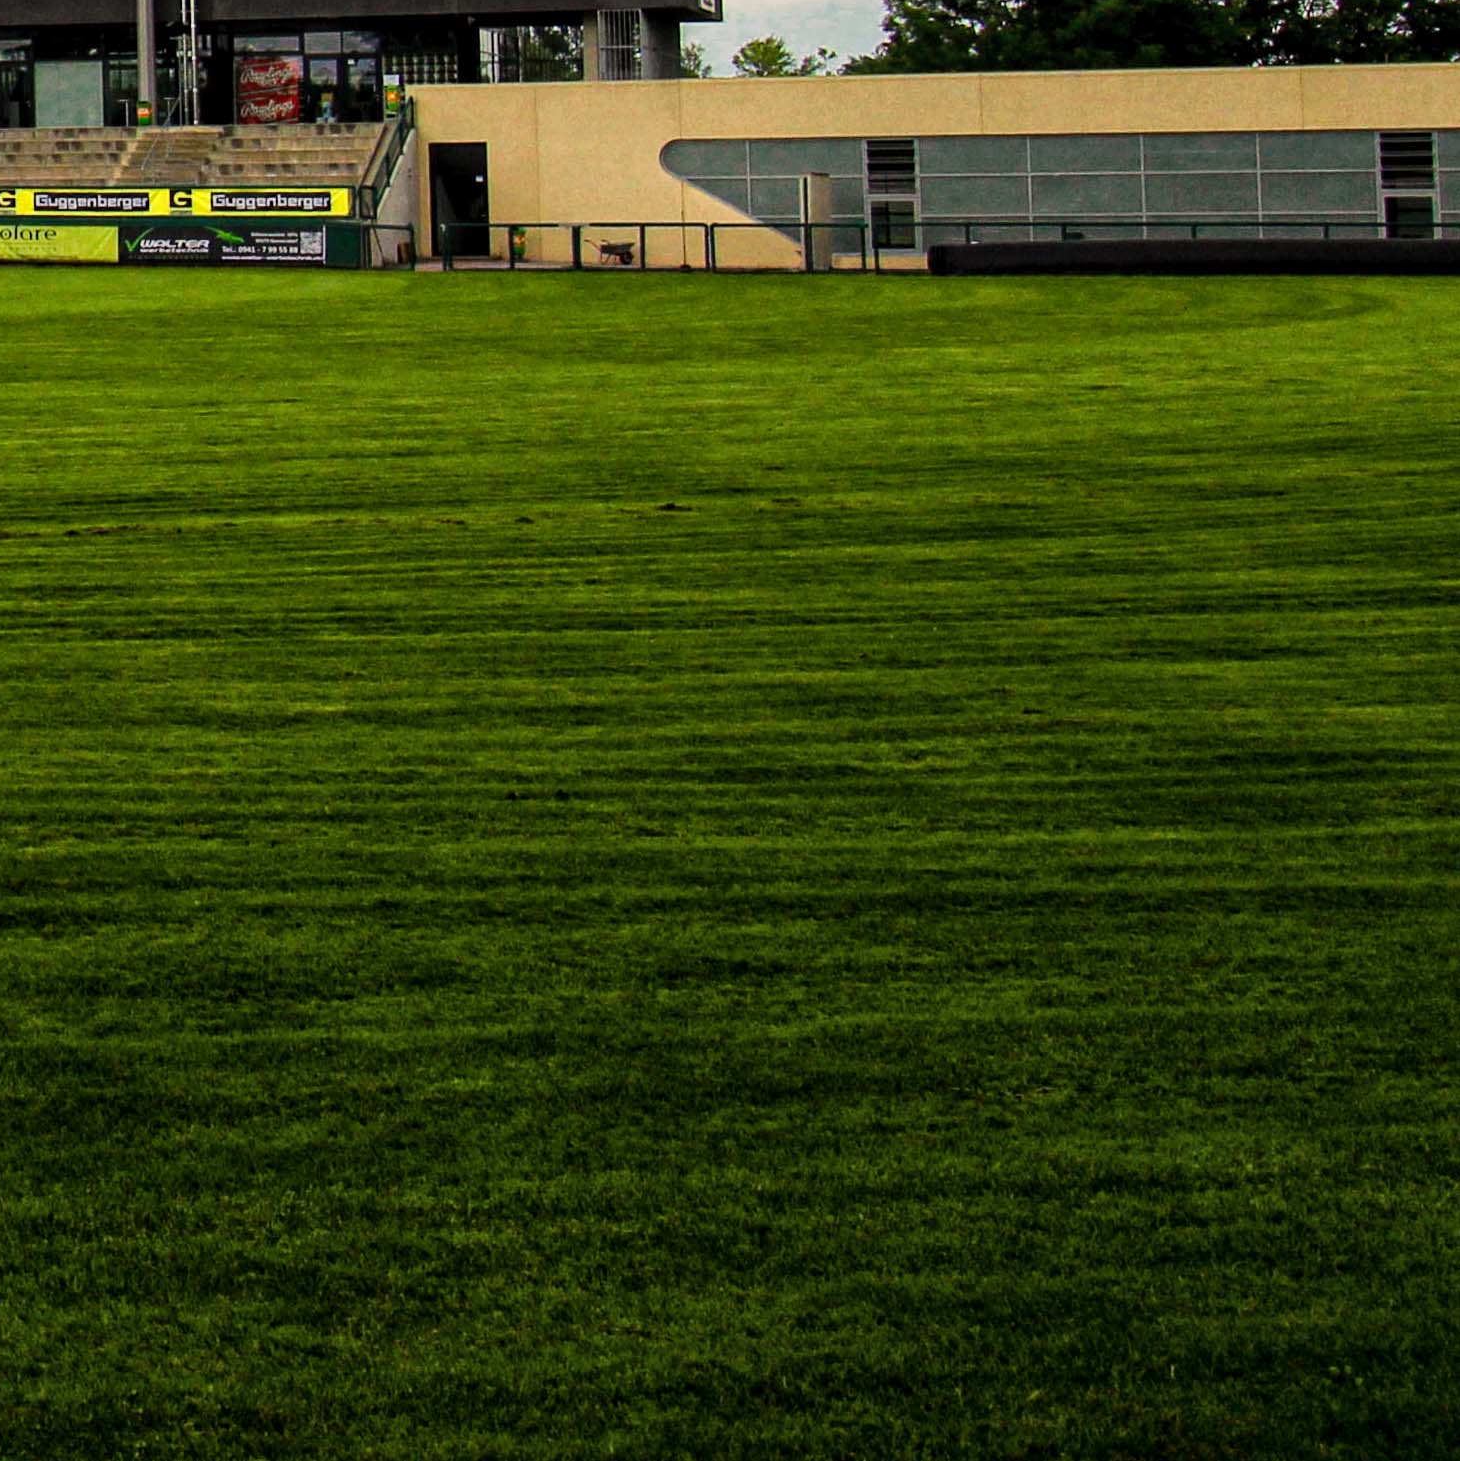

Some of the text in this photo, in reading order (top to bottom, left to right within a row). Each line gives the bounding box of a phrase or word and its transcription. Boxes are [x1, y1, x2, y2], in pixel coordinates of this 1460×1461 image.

[35, 194, 150, 209] Guggenberger
[212, 194, 330, 209] Guggenberger
[139, 239, 211, 248] WALTER
